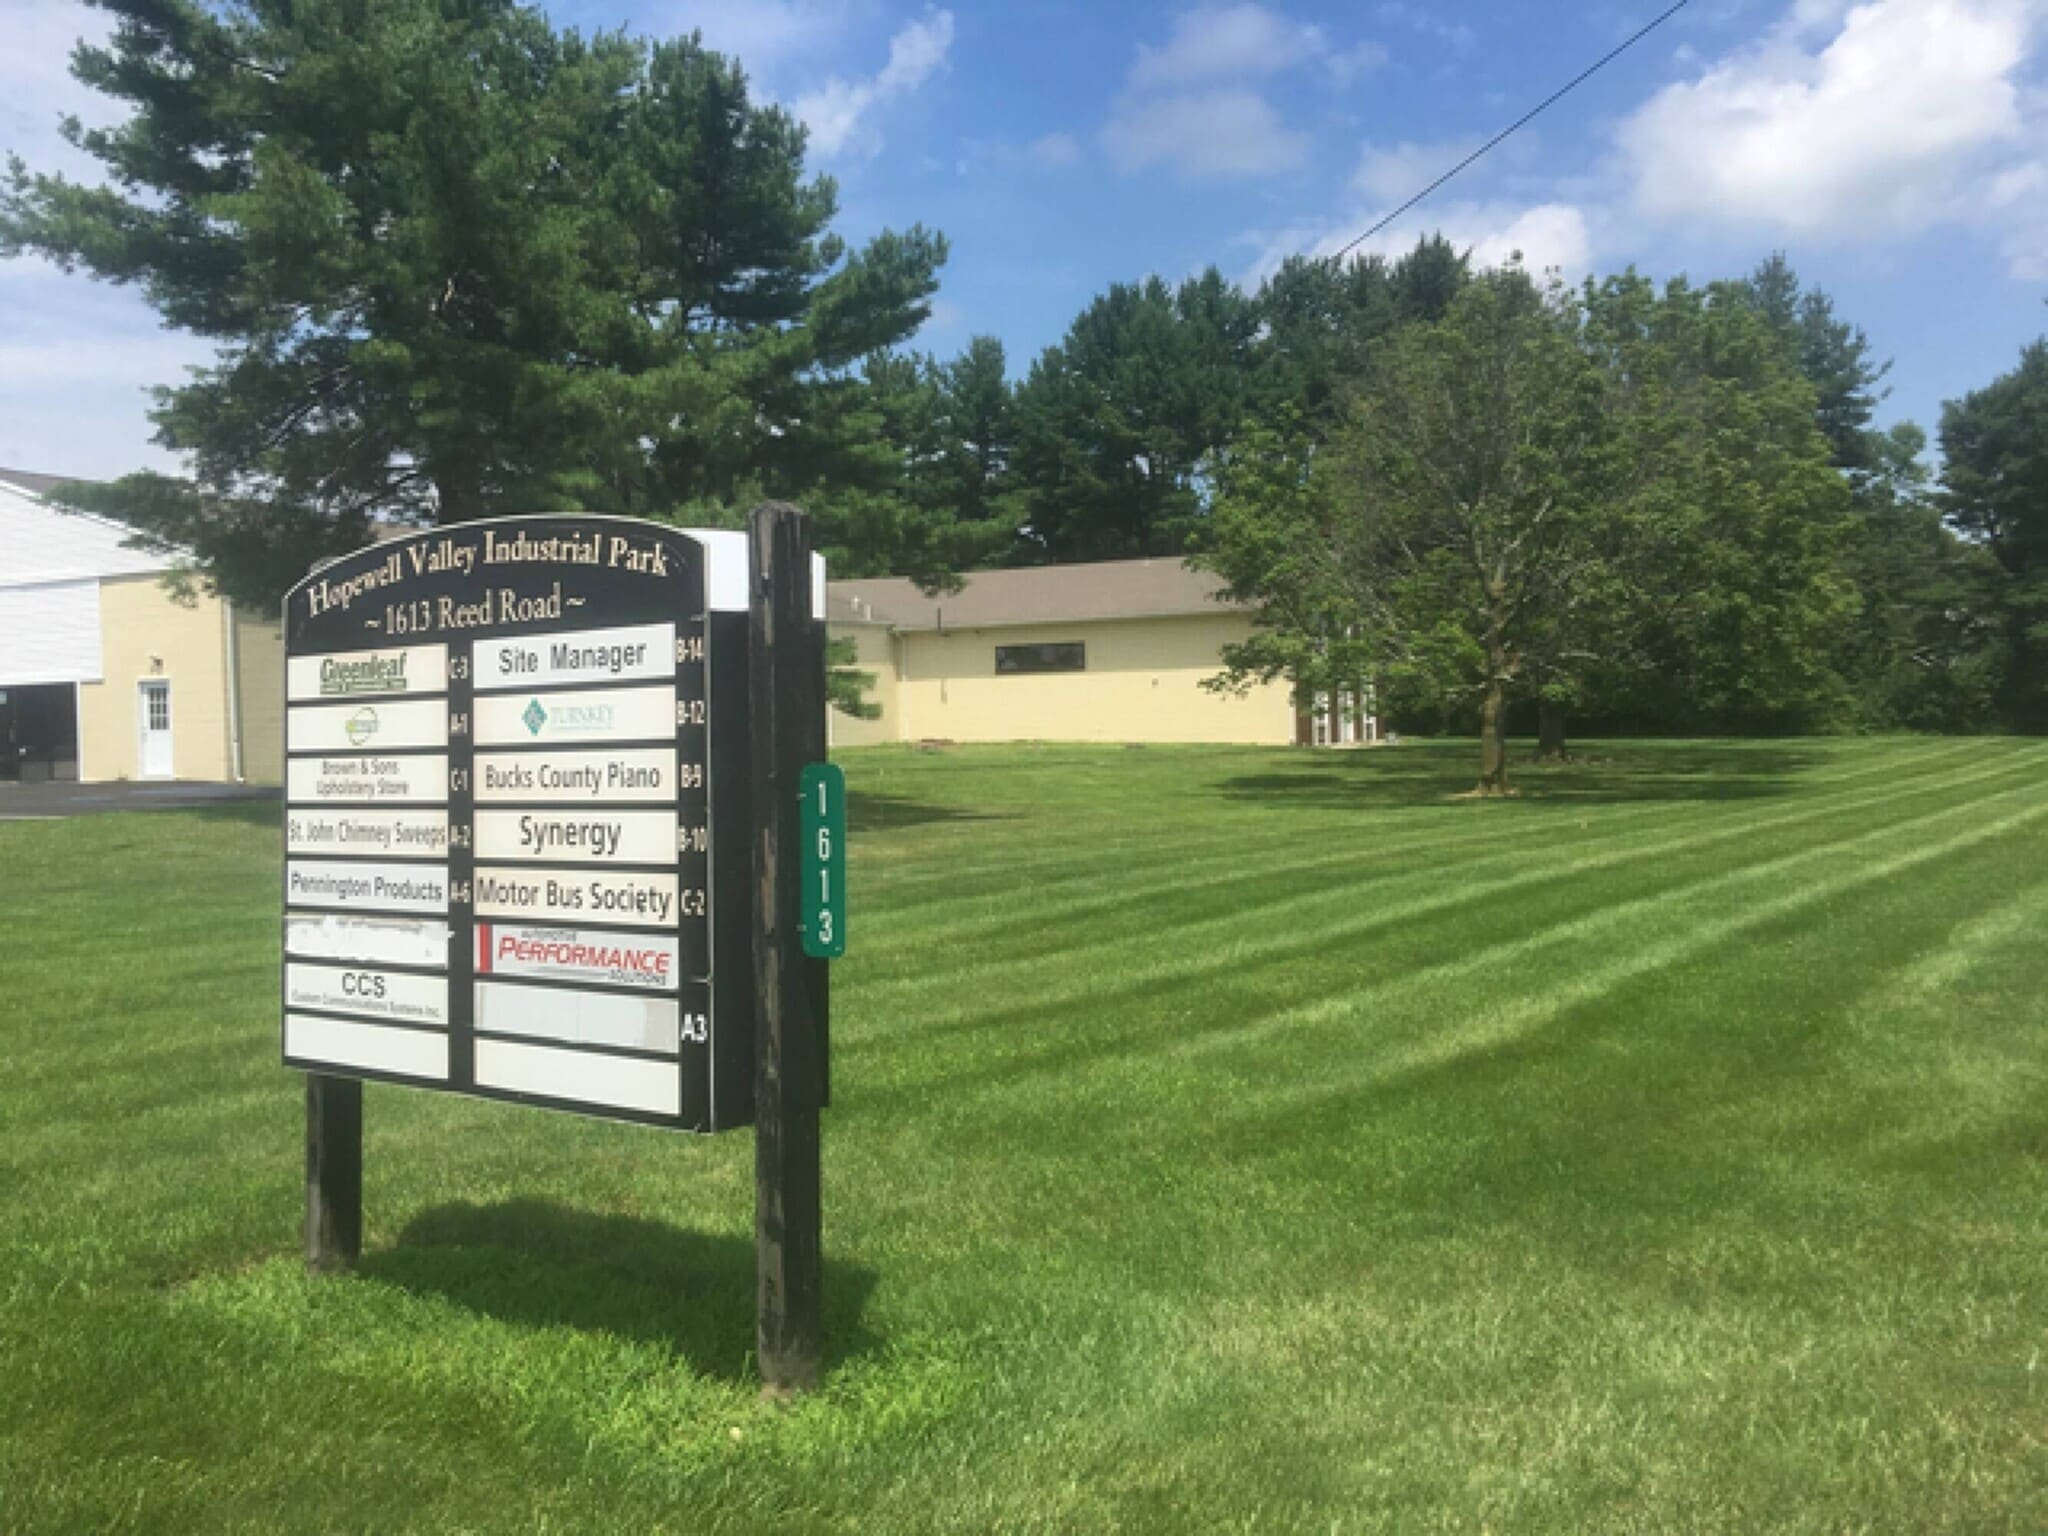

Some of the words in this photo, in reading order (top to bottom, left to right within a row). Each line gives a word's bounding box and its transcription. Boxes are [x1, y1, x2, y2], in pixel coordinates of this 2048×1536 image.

[307, 553, 403, 618] Hopewell
[406, 541, 477, 576] Valley
[483, 530, 602, 565] Industrial
[608, 537, 670, 577] Park
[386, 600, 432, 634] 1613
[438, 588, 493, 629] Reed
[499, 581, 561, 624] Road
[320, 651, 407, 682] Greenleaf
[499, 648, 538, 675] Site
[550, 642, 647, 673] Manager
[371, 757, 398, 775] Sons
[486, 764, 533, 789] Bucks
[540, 764, 601, 794] County
[607, 761, 662, 788] Piano
[306, 819, 335, 842] John
[338, 819, 392, 848] Chimney
[520, 815, 621, 855] Synergy
[817, 780, 833, 944] 1613
[291, 871, 372, 900] Pennington
[374, 876, 443, 902] Products
[476, 877, 540, 906] Motor
[546, 880, 583, 907] Bus
[590, 882, 672, 921] Society
[499, 936, 671, 973] PERFORMANCE
[342, 973, 386, 998] CCS
[681, 1014, 708, 1044] A3
